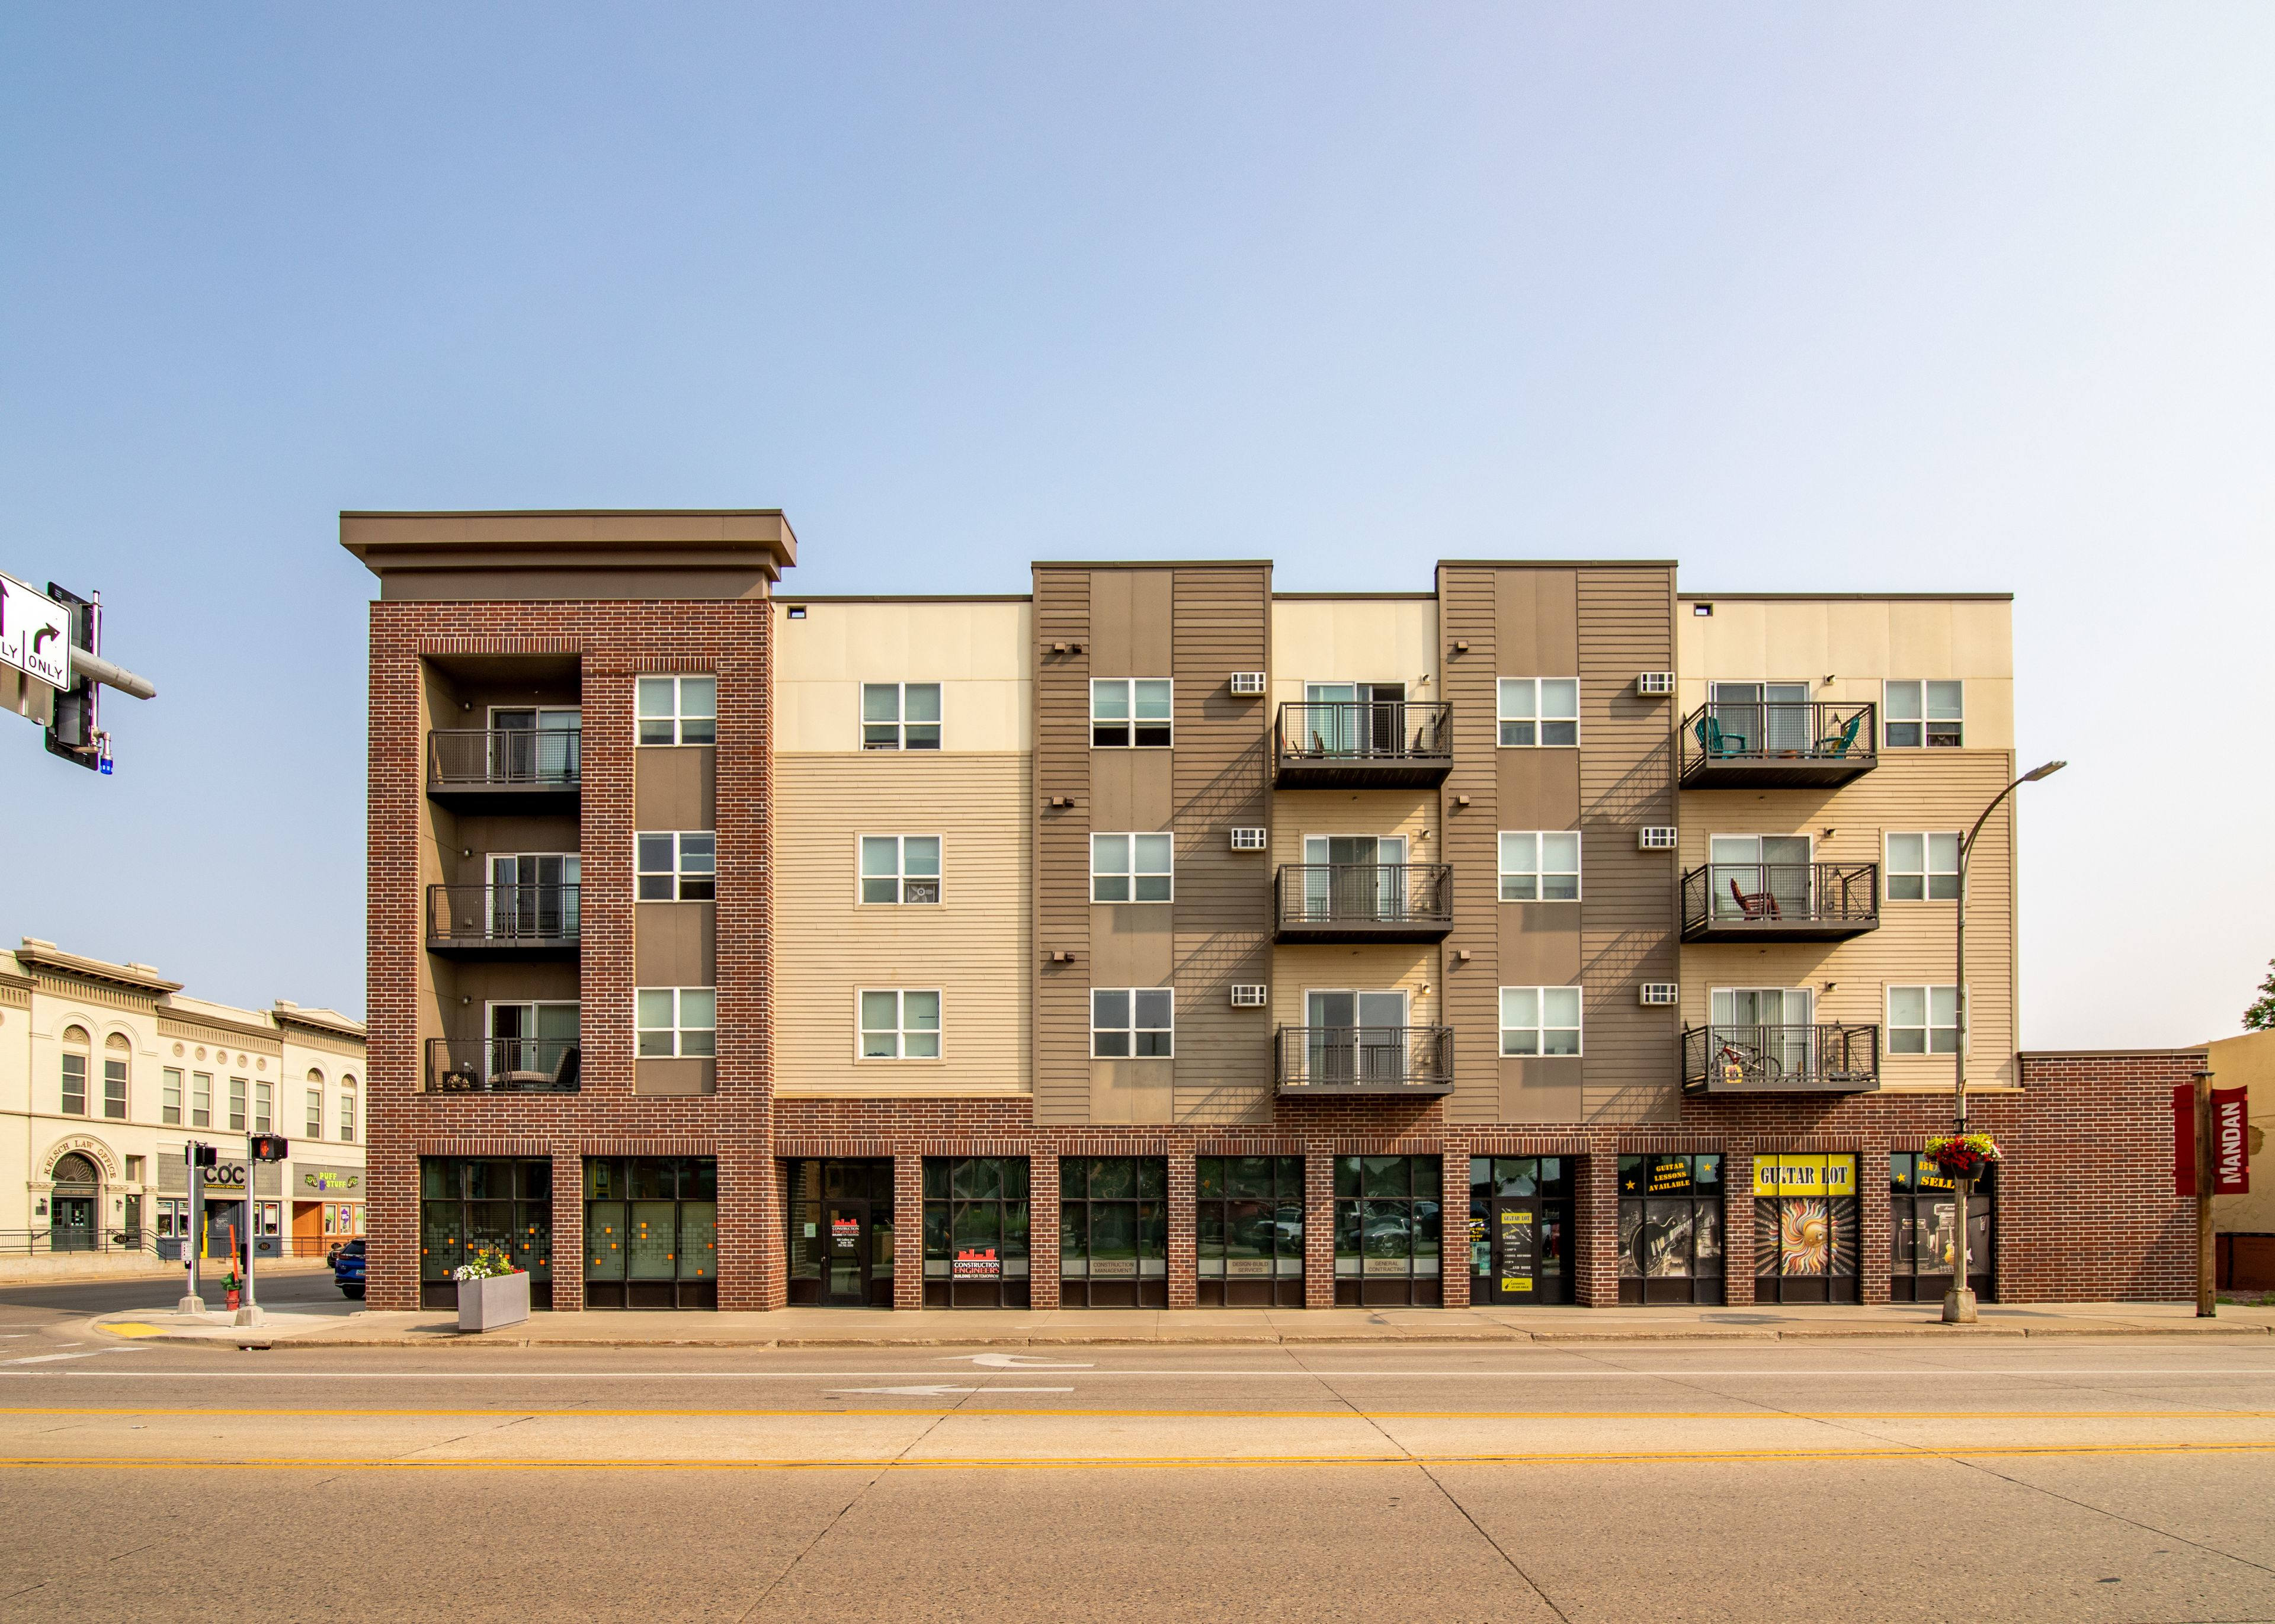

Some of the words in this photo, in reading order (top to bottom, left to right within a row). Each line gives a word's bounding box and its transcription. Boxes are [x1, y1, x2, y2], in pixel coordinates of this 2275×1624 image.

[2, 641, 18, 658] LY
[28, 655, 62, 680] ONLY
[2219, 1102, 2241, 1183] MANDAN
[44, 1142, 70, 1175] KELSCH
[75, 1140, 94, 1149] LAW
[97, 1148, 117, 1179] OFFICE
[1655, 1163, 1685, 1172] GUITAR
[1918, 1161, 1938, 1172] BU
[1654, 1171, 1687, 1182] LESSONS
[1821, 1166, 1848, 1185] LOT
[326, 1180, 346, 1188] STUFF
[1649, 1180, 1690, 1192] AVAILABLE
[1920, 1176, 1955, 1189] SELL
